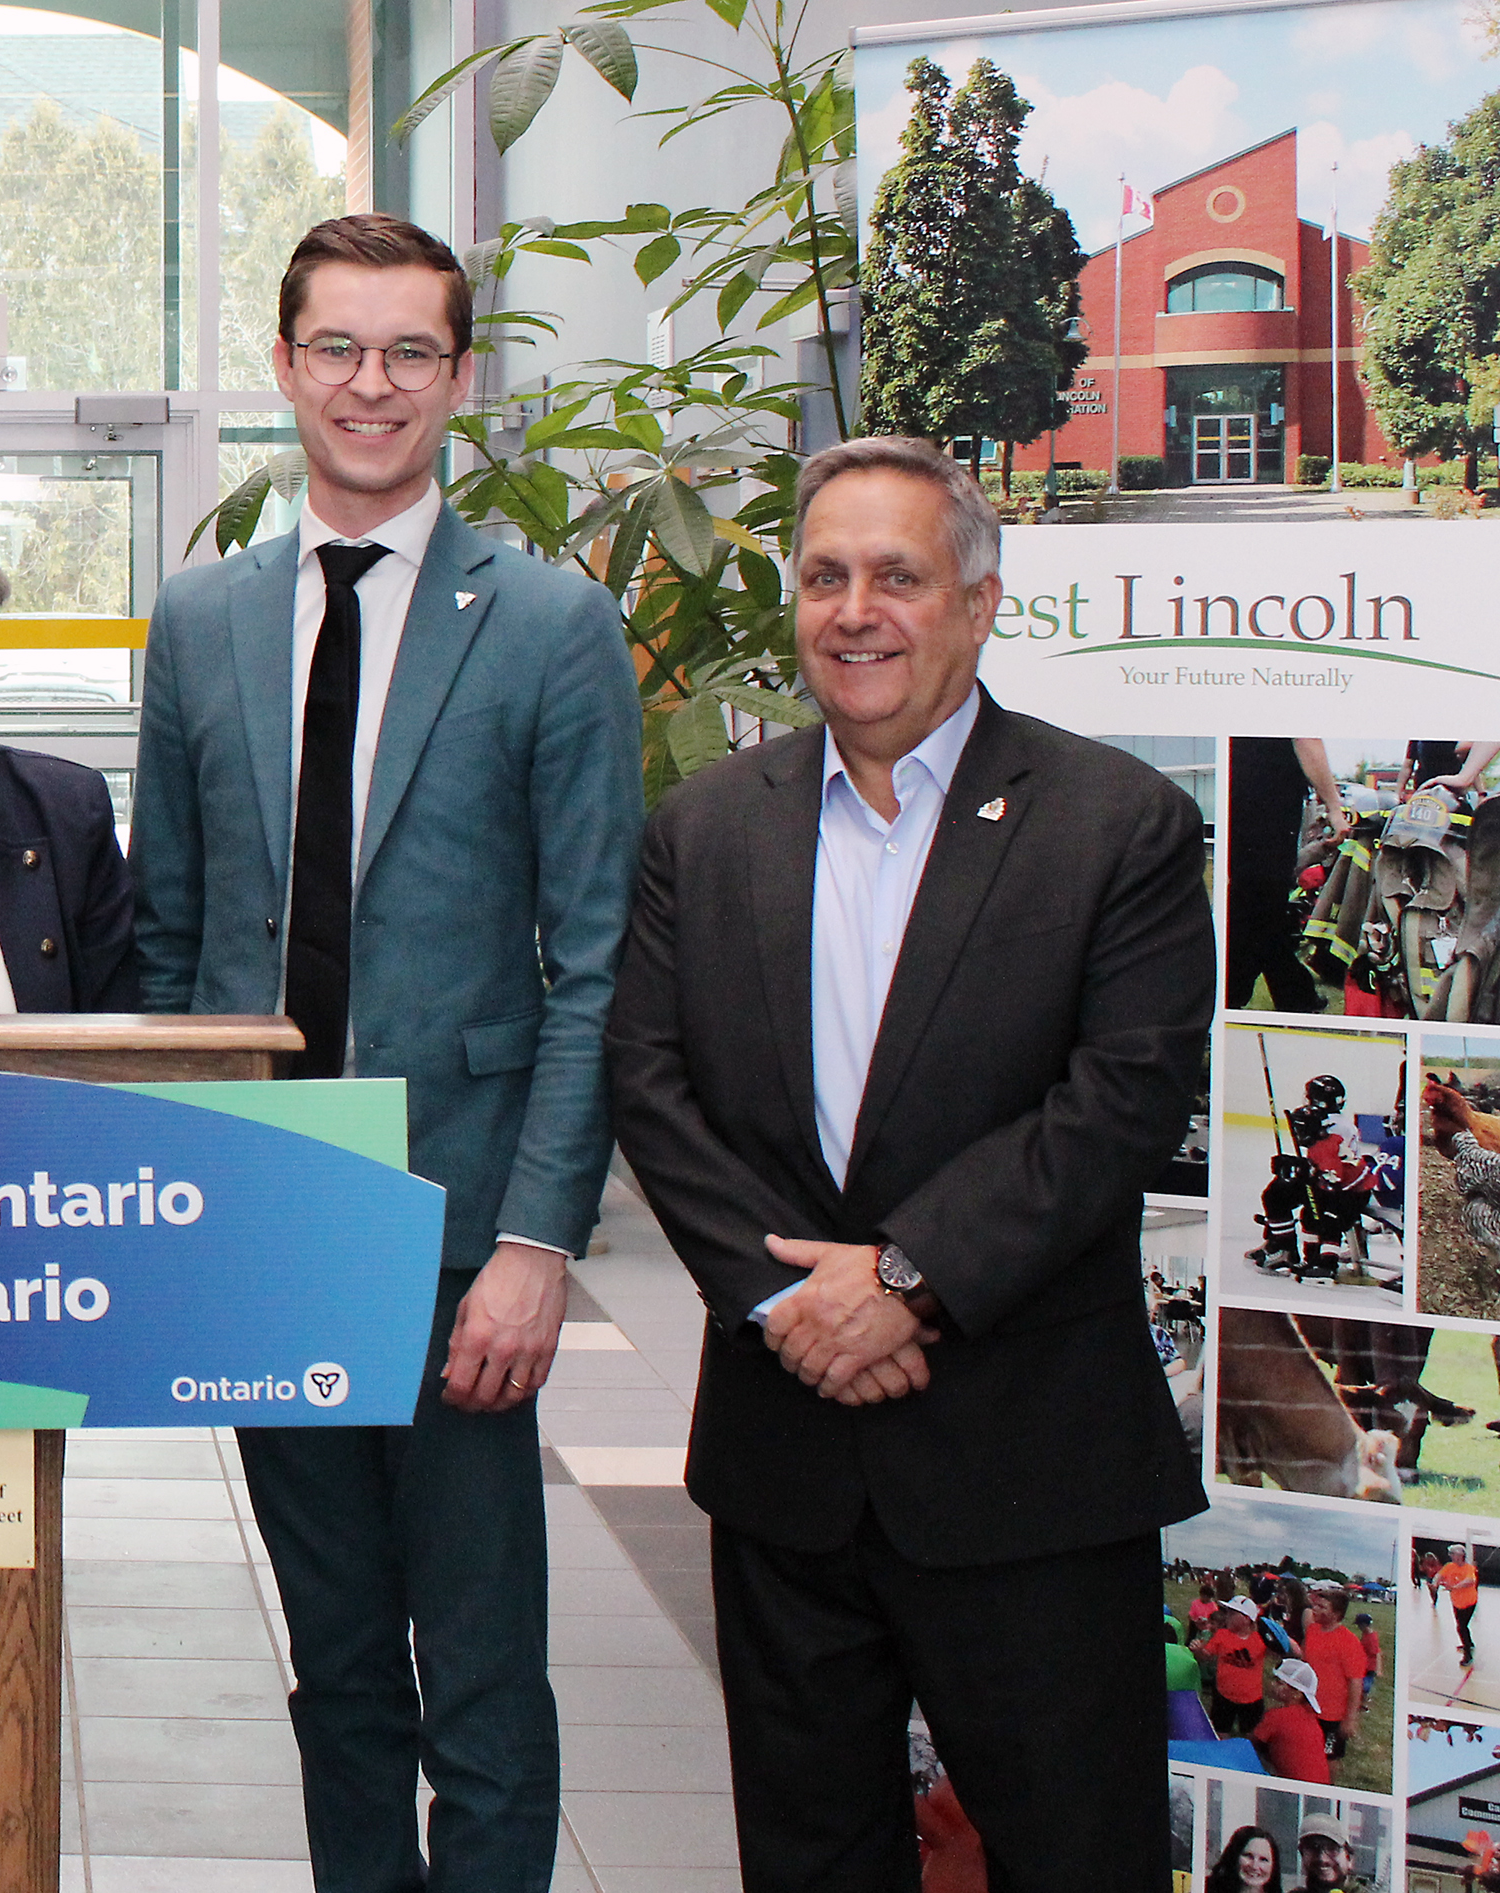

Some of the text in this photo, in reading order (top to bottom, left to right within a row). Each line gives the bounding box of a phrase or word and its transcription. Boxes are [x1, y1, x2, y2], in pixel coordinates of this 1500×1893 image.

[1079, 377, 1096, 388] OF
[990, 571, 1420, 641] est Lincoln
[1120, 666, 1353, 693] Your Future Naturally
[171, 1374, 297, 1402] Ontario
